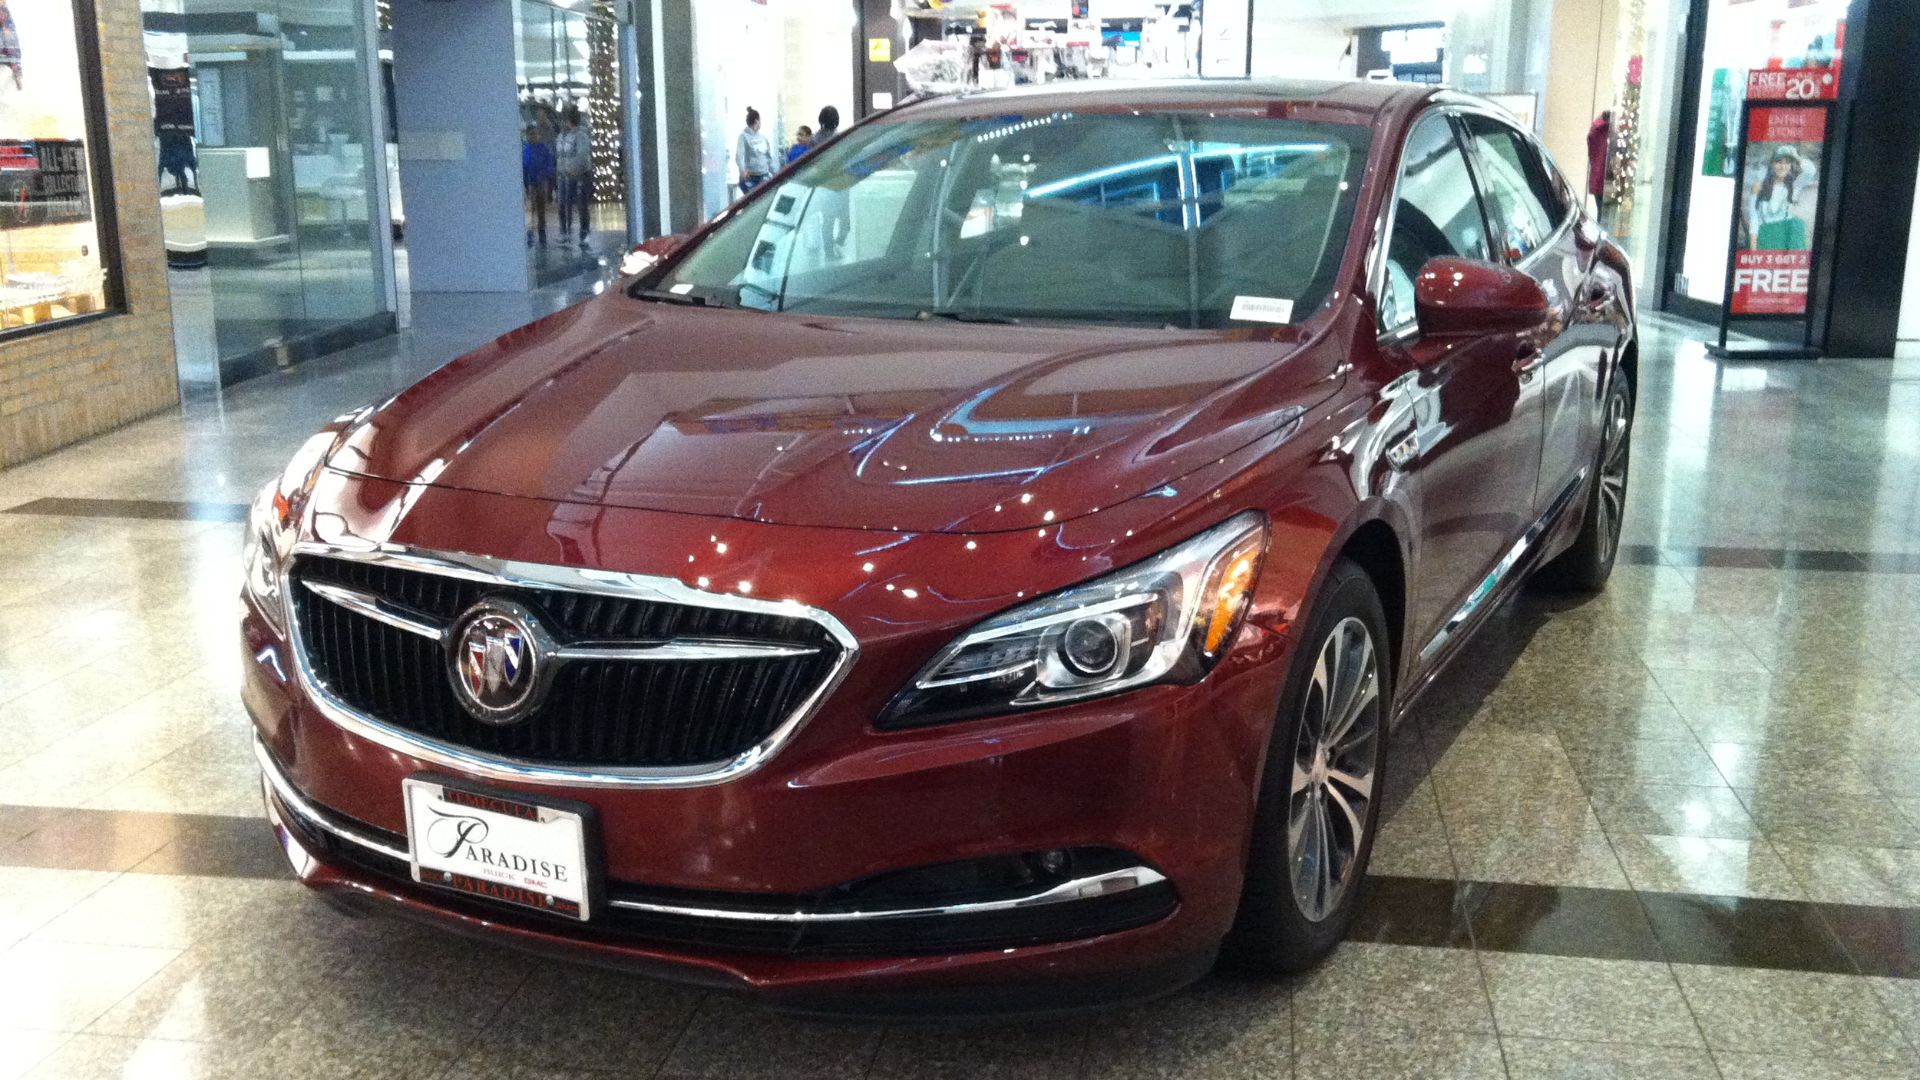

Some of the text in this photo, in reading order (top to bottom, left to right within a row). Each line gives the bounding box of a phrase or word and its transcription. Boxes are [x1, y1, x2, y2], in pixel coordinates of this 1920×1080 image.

[1749, 72, 1786, 87] FREE
[1785, 78, 1815, 99] 20
[1740, 254, 1763, 264] BUY
[1775, 254, 1796, 264] GET
[1733, 268, 1810, 293] FREE
[427, 804, 568, 882] PARADISE
